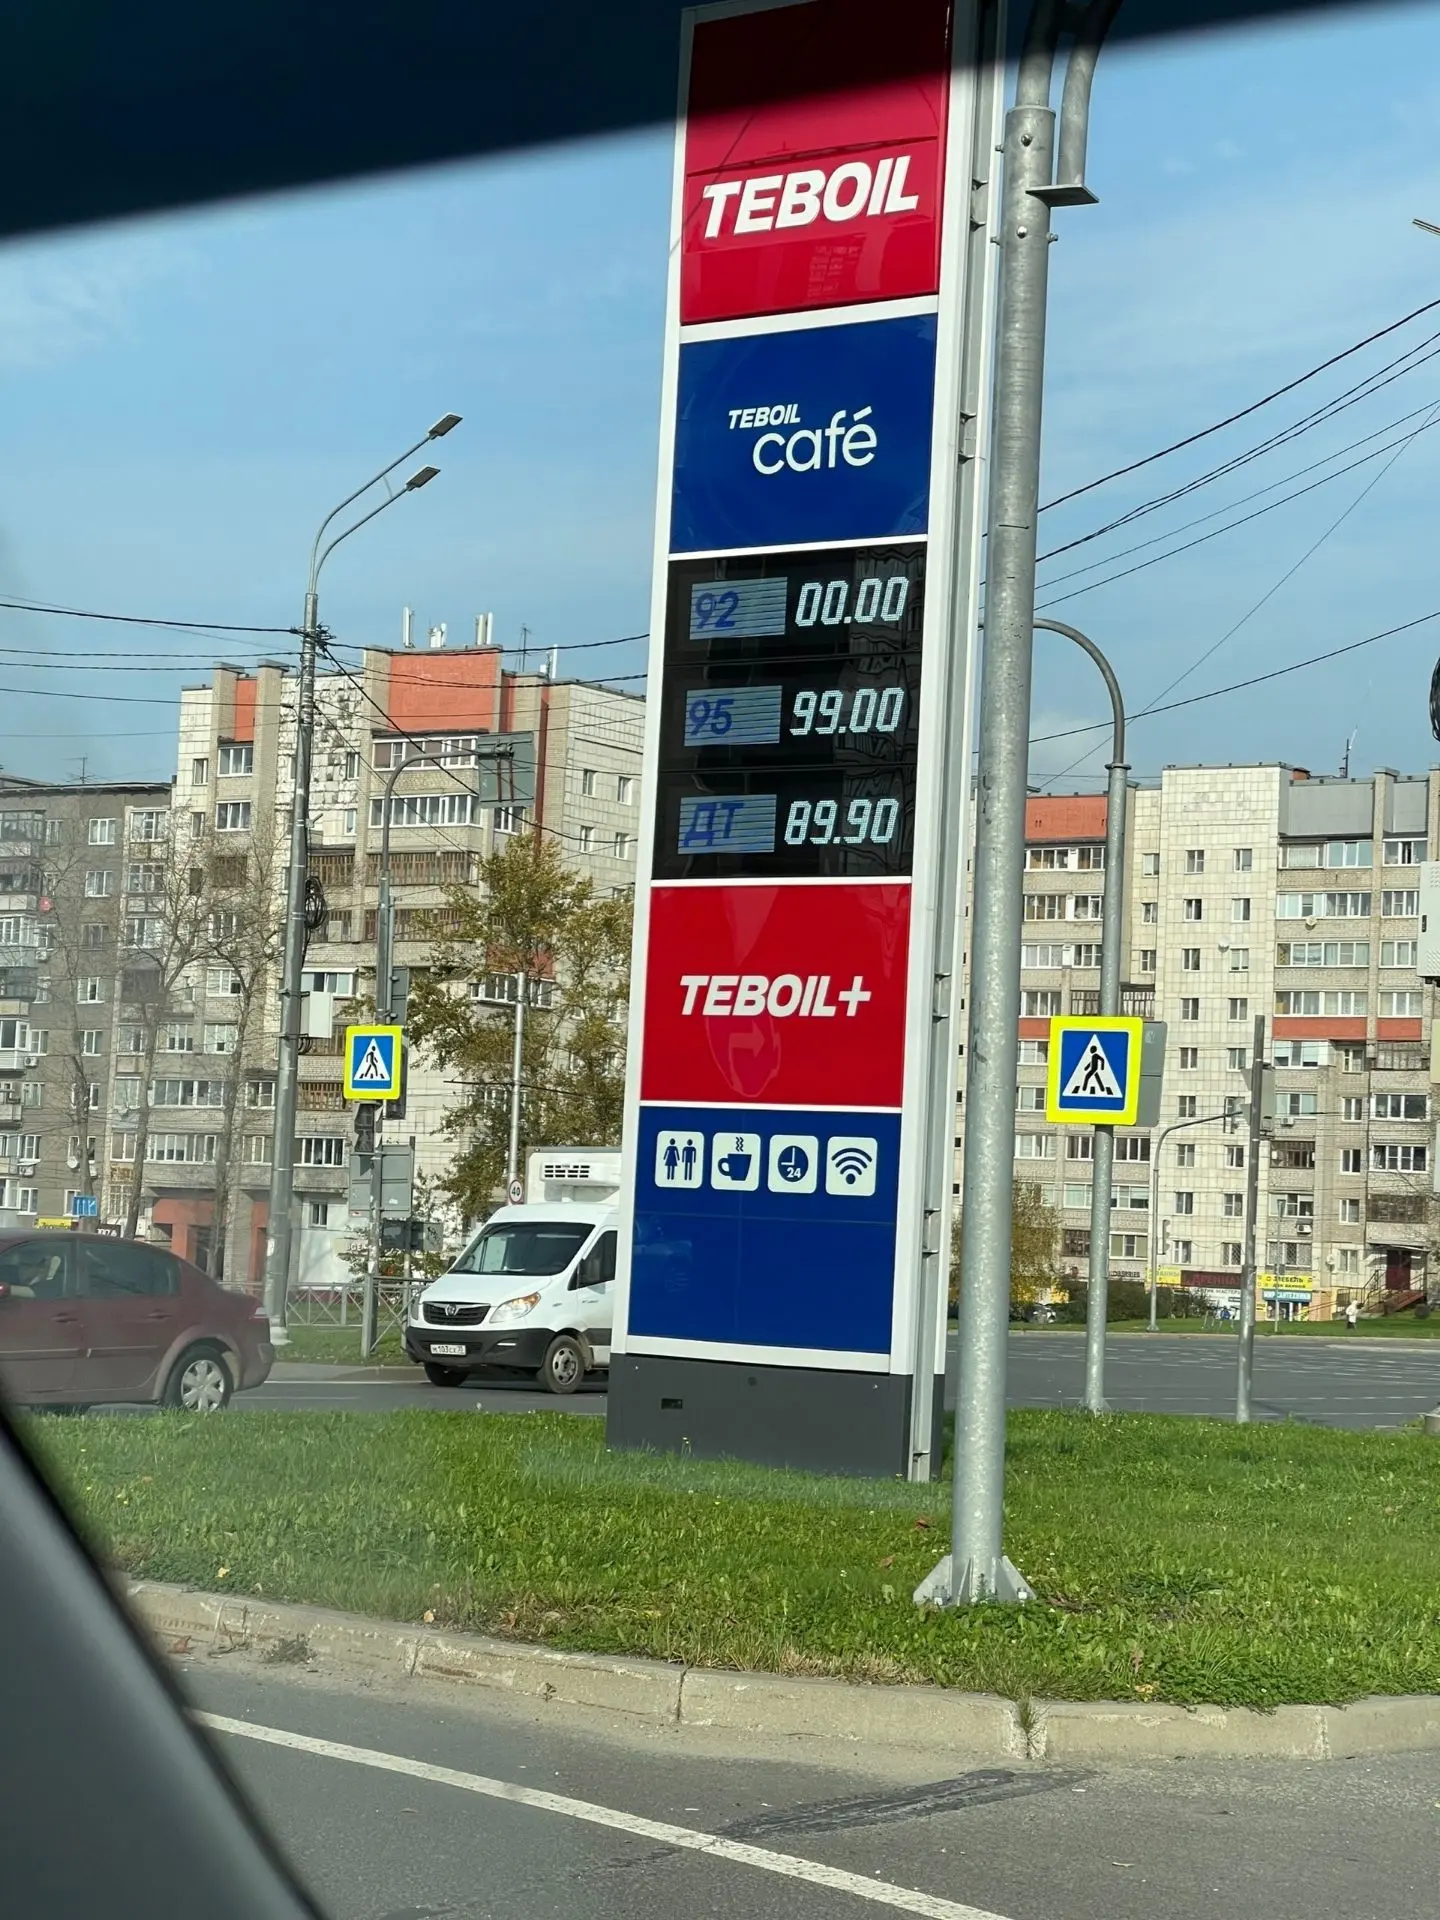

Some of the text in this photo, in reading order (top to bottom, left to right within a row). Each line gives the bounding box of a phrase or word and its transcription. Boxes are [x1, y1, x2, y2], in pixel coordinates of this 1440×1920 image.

[703, 156, 919, 239] TEBOIL
[728, 403, 801, 430] TEBOIL
[752, 406, 877, 475] café
[694, 576, 909, 630] 92 00.00
[688, 687, 905, 736] 95 99.00
[682, 798, 900, 848] ДТ 89.90
[680, 973, 872, 1018] TEBOIL+
[511, 1186, 521, 1196] 40
[786, 1167, 801, 1178] 24
